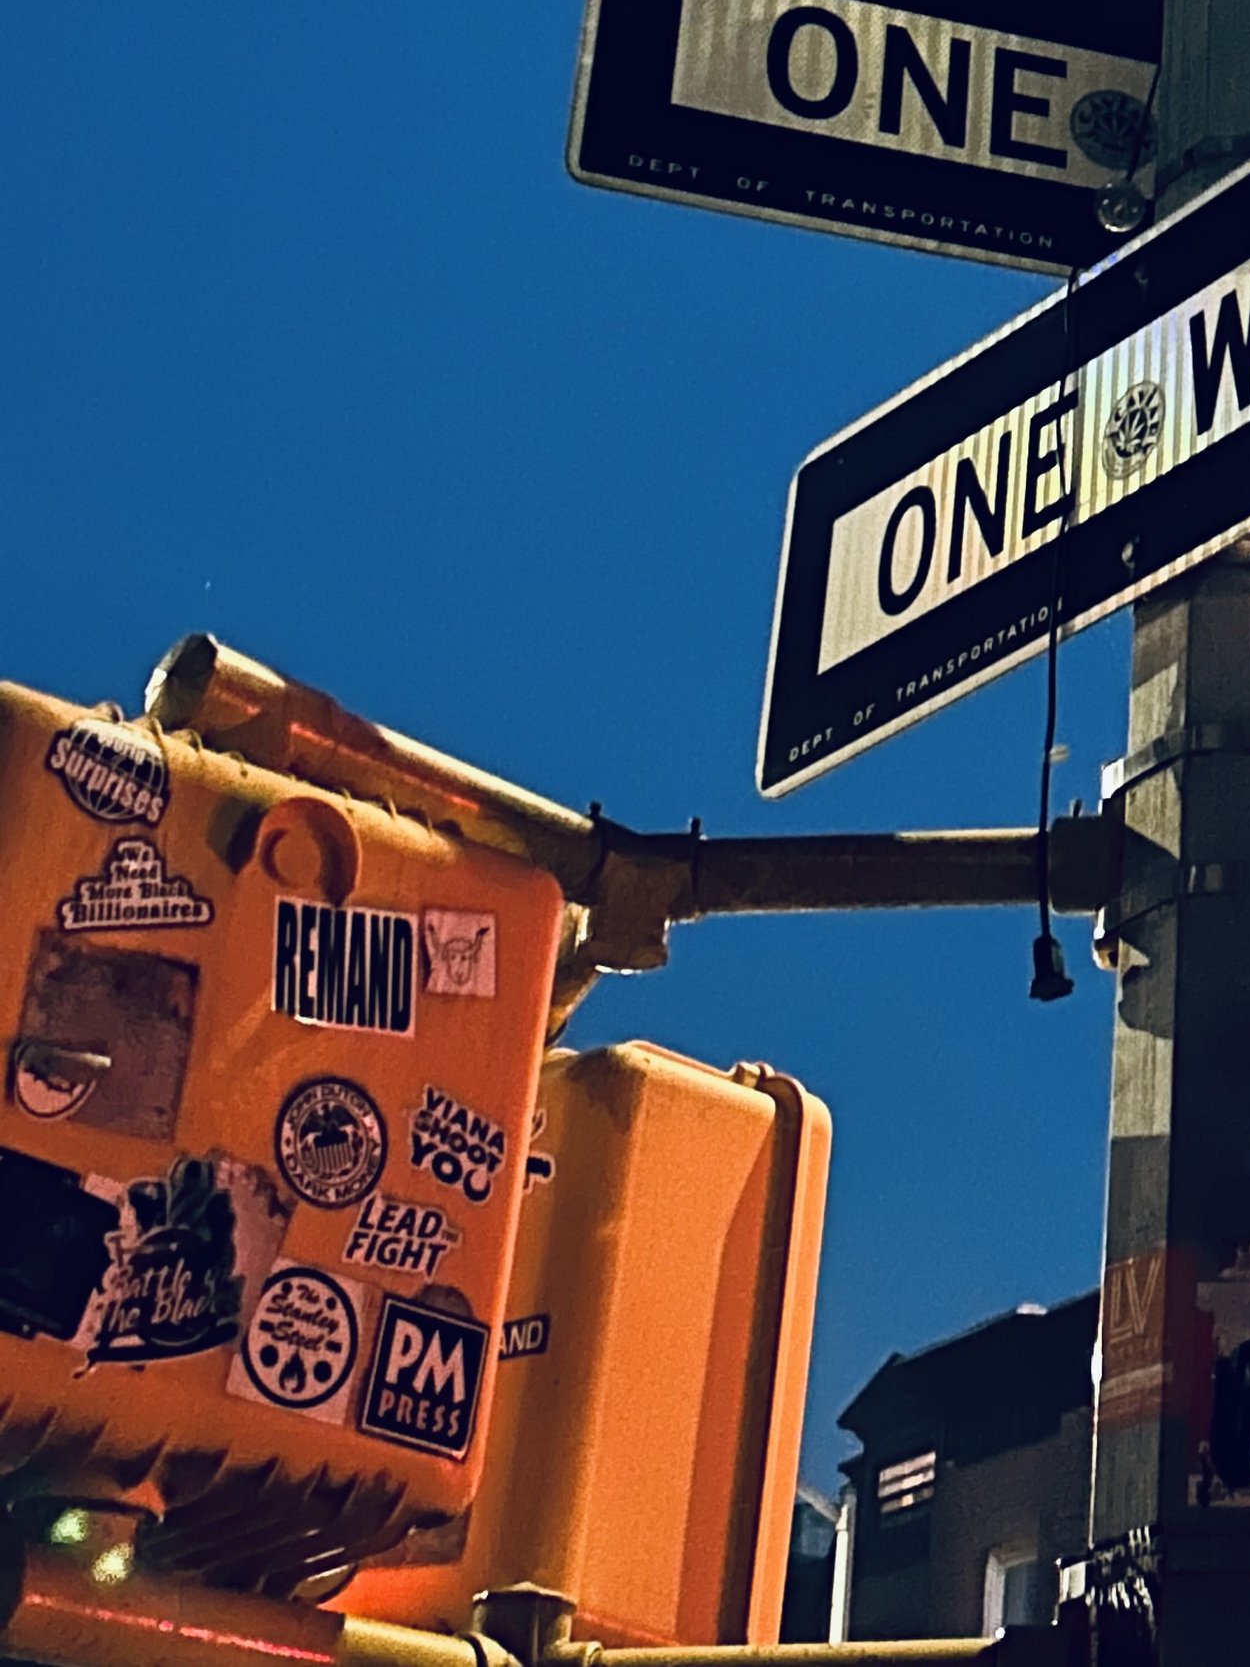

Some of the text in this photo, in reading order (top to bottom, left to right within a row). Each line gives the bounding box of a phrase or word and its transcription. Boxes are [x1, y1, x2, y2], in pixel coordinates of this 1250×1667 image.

[767, 5, 1068, 169] ONE
[629, 154, 1053, 248] DEPT OF TRANSPORTATION
[878, 387, 1079, 617] ONE
[789, 727, 833, 762] DEPT
[853, 704, 876, 727] OF
[51, 737, 164, 822] Surprises
[86, 885, 132, 900] More
[115, 864, 158, 880] Need
[70, 901, 204, 924] Billionaires
[275, 900, 413, 1032] REMAND
[411, 1131, 491, 1202] YOU
[358, 1195, 443, 1238] LEAD
[345, 1231, 447, 1277] FIGHT
[265, 1294, 340, 1335] Stanley
[385, 1318, 466, 1403] PM
[377, 1389, 461, 1438] PRESS
